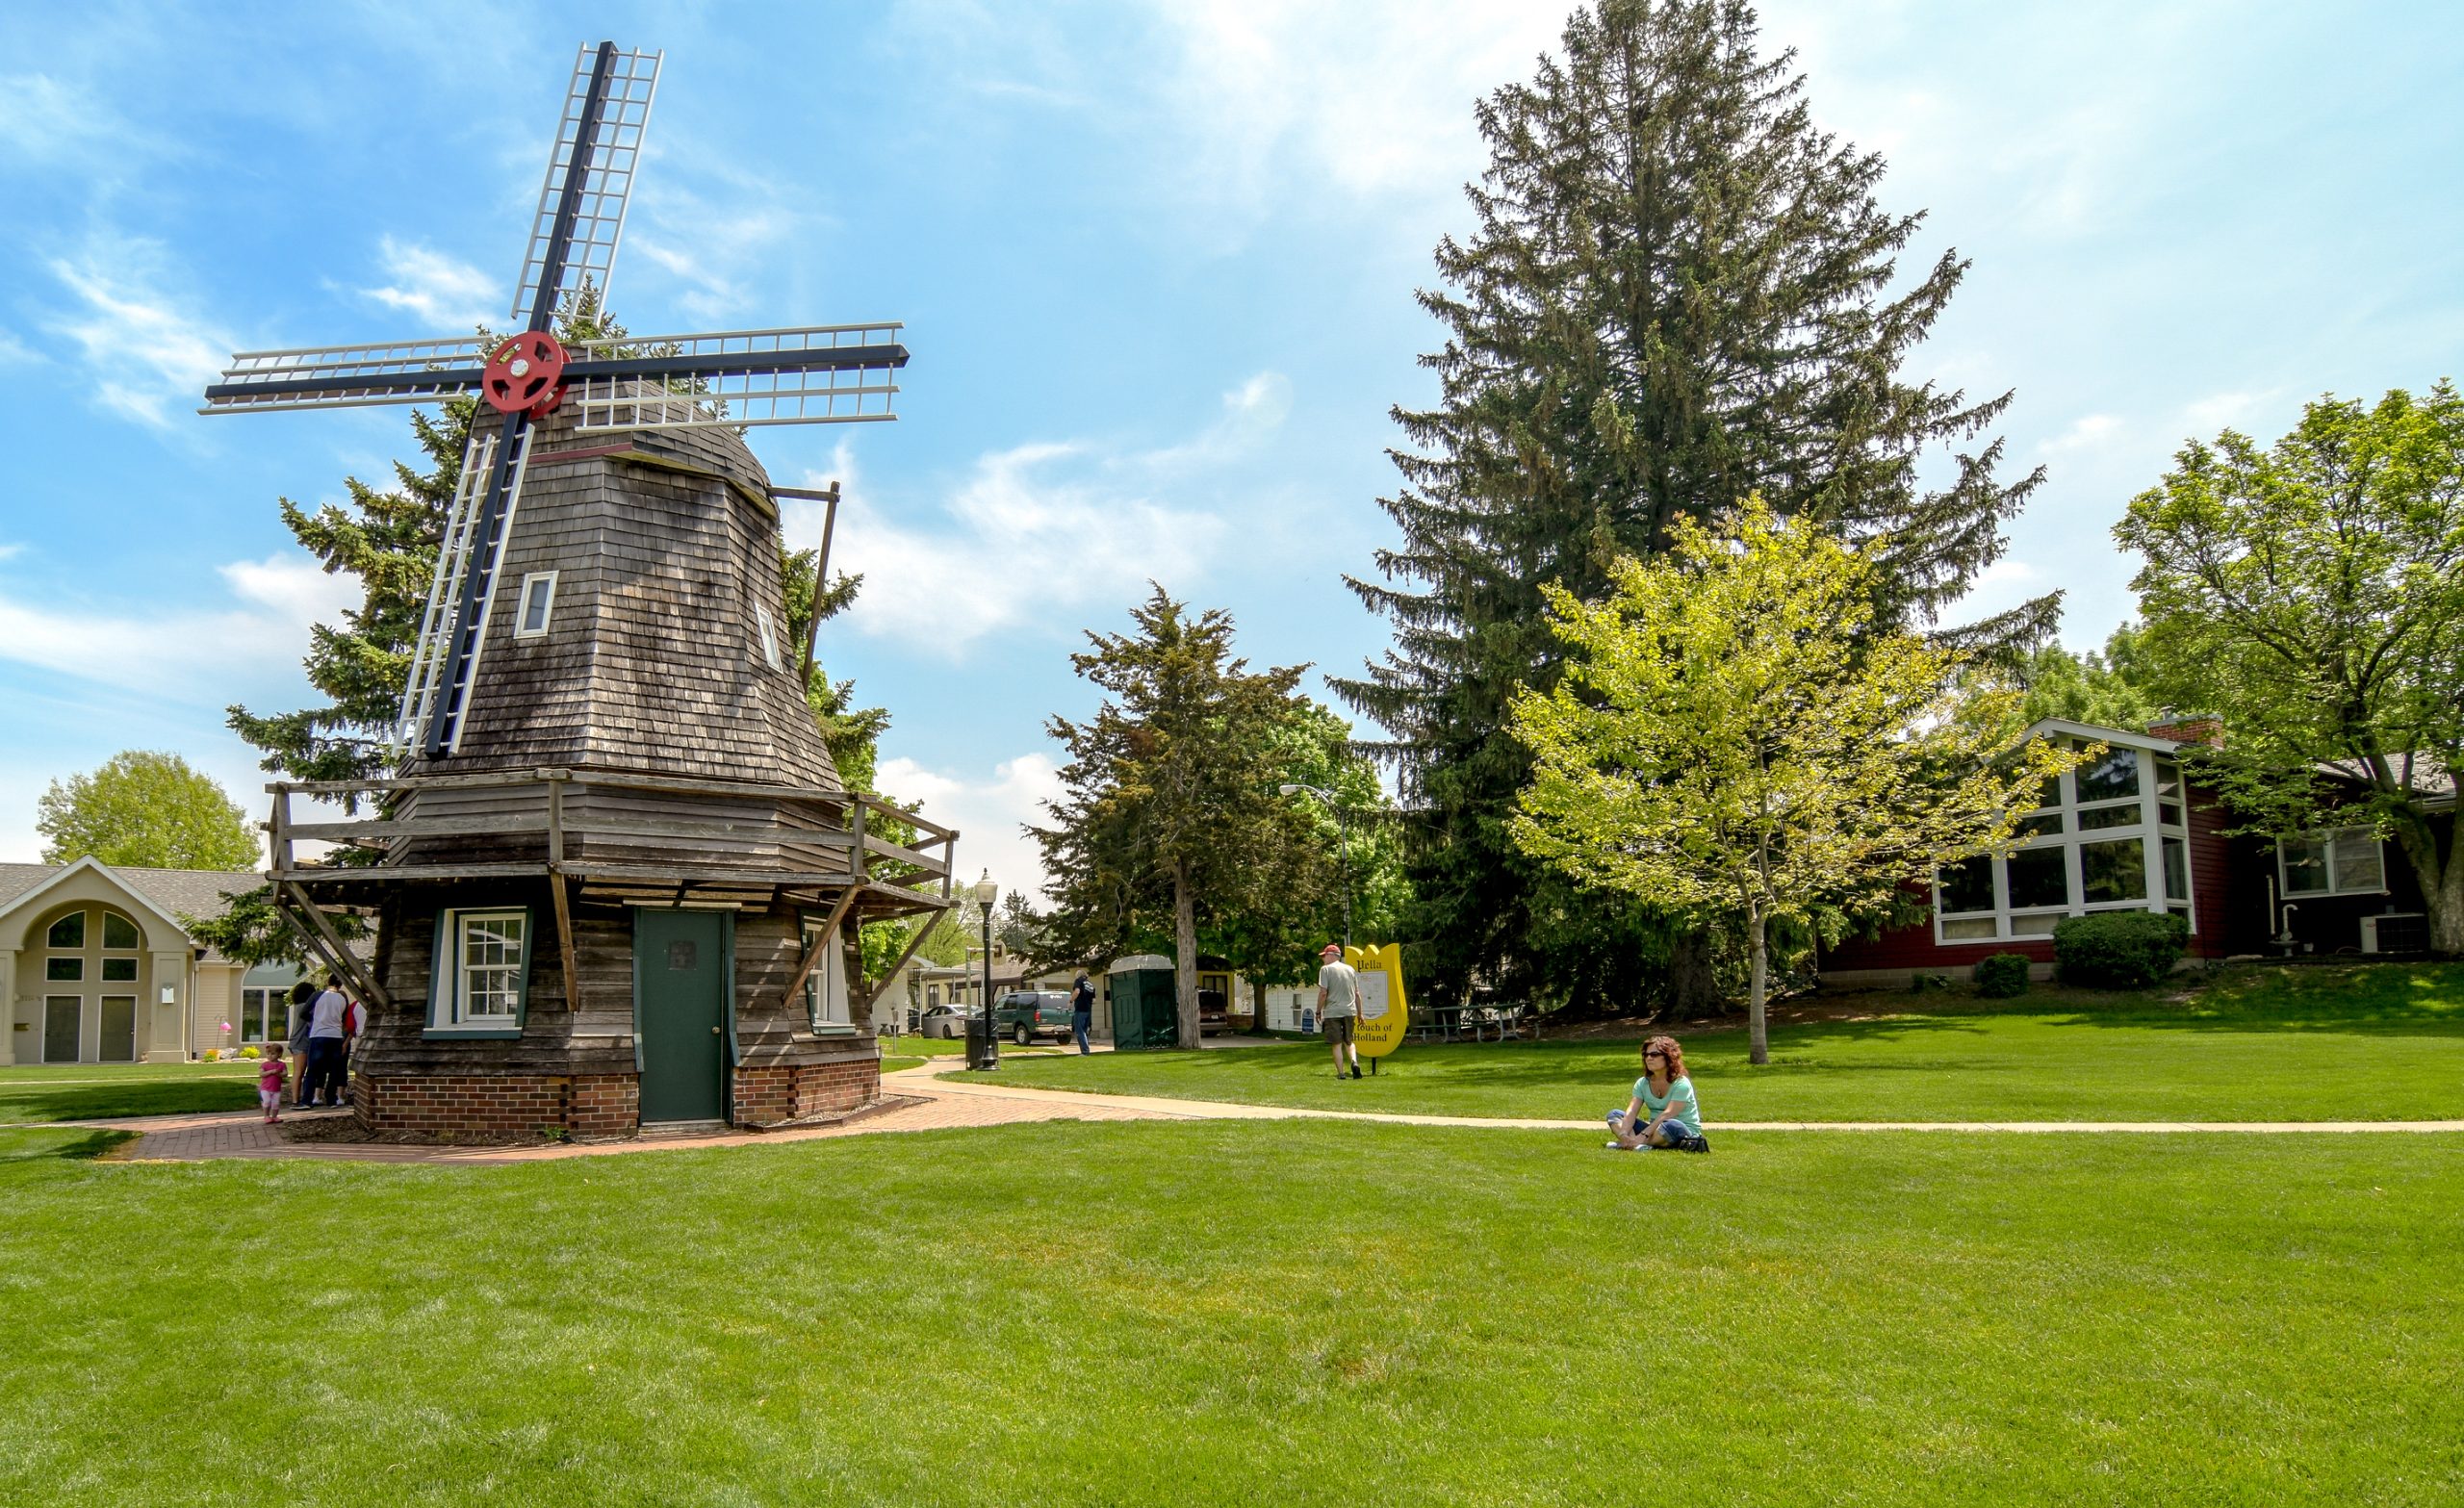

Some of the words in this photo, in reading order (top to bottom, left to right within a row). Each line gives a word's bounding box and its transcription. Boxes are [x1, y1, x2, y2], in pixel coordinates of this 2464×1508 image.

[1356, 959, 1382, 973] Pella
[1383, 1022, 1393, 1032] of
[1353, 1033, 1387, 1042] Holland
